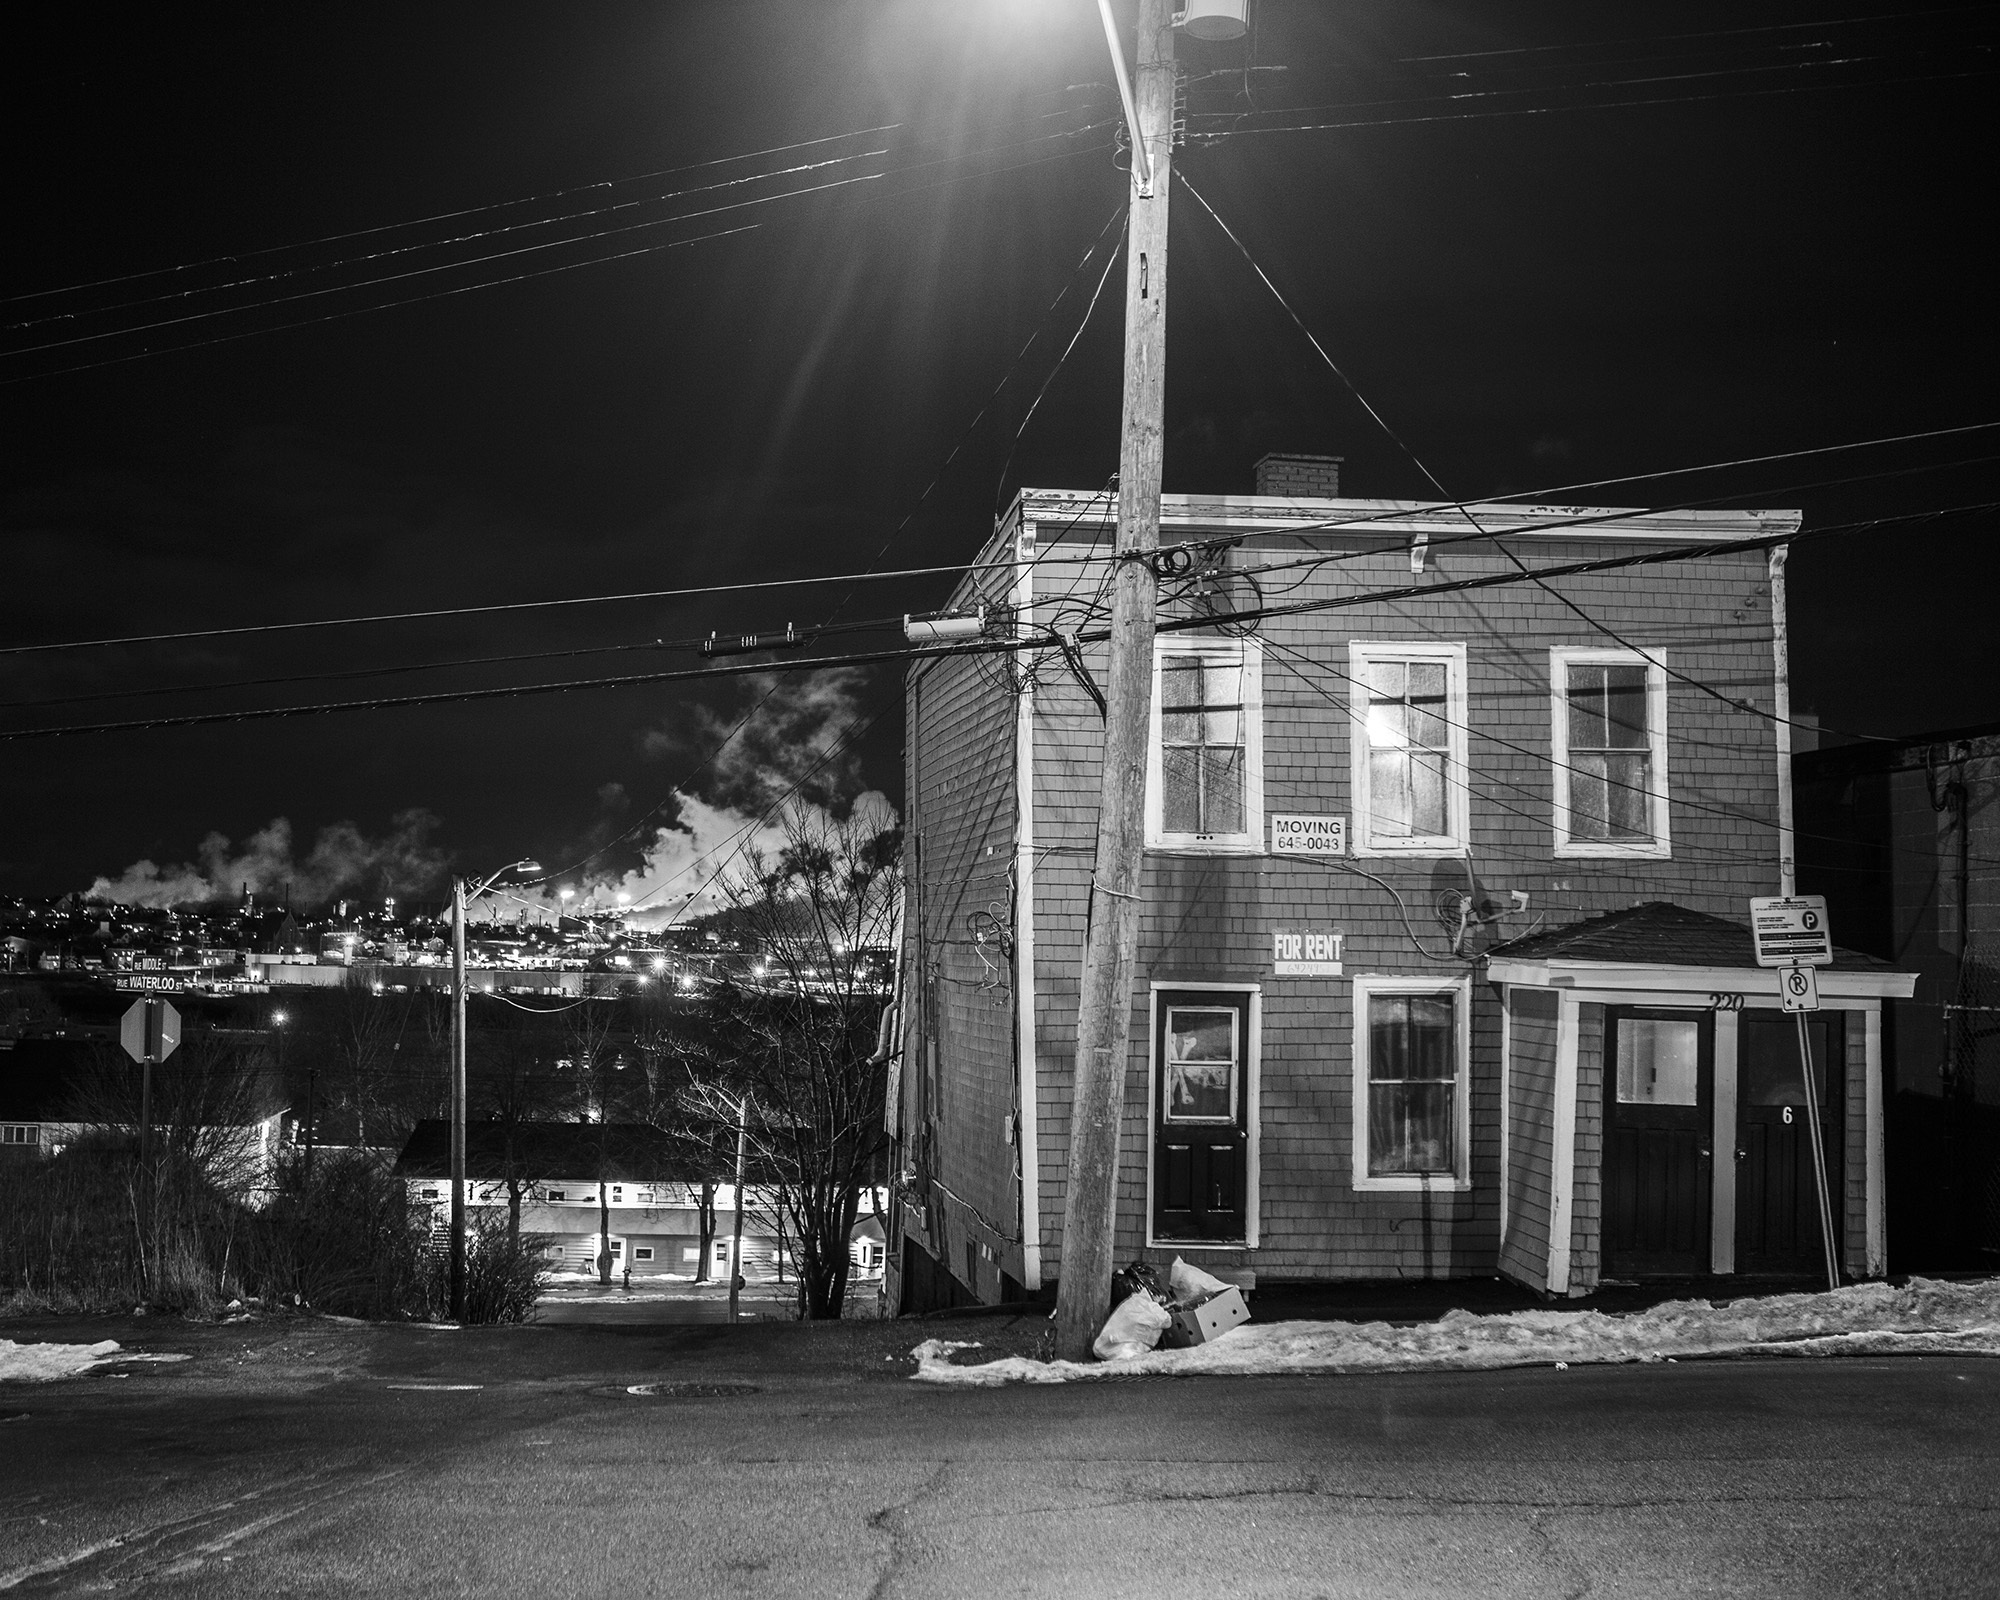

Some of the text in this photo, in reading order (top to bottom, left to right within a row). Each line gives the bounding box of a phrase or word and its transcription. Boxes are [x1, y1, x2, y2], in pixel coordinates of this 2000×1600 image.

[1276, 820, 1342, 835] MOVING
[1278, 836, 1340, 851] 645-0043
[1274, 934, 1342, 960] FOR RENT
[142, 958, 161, 970] MIDDLE
[116, 976, 183, 991] RUE WATERLOO ST
[1709, 992, 1745, 1012] 220
[1782, 1106, 1793, 1124] 6
